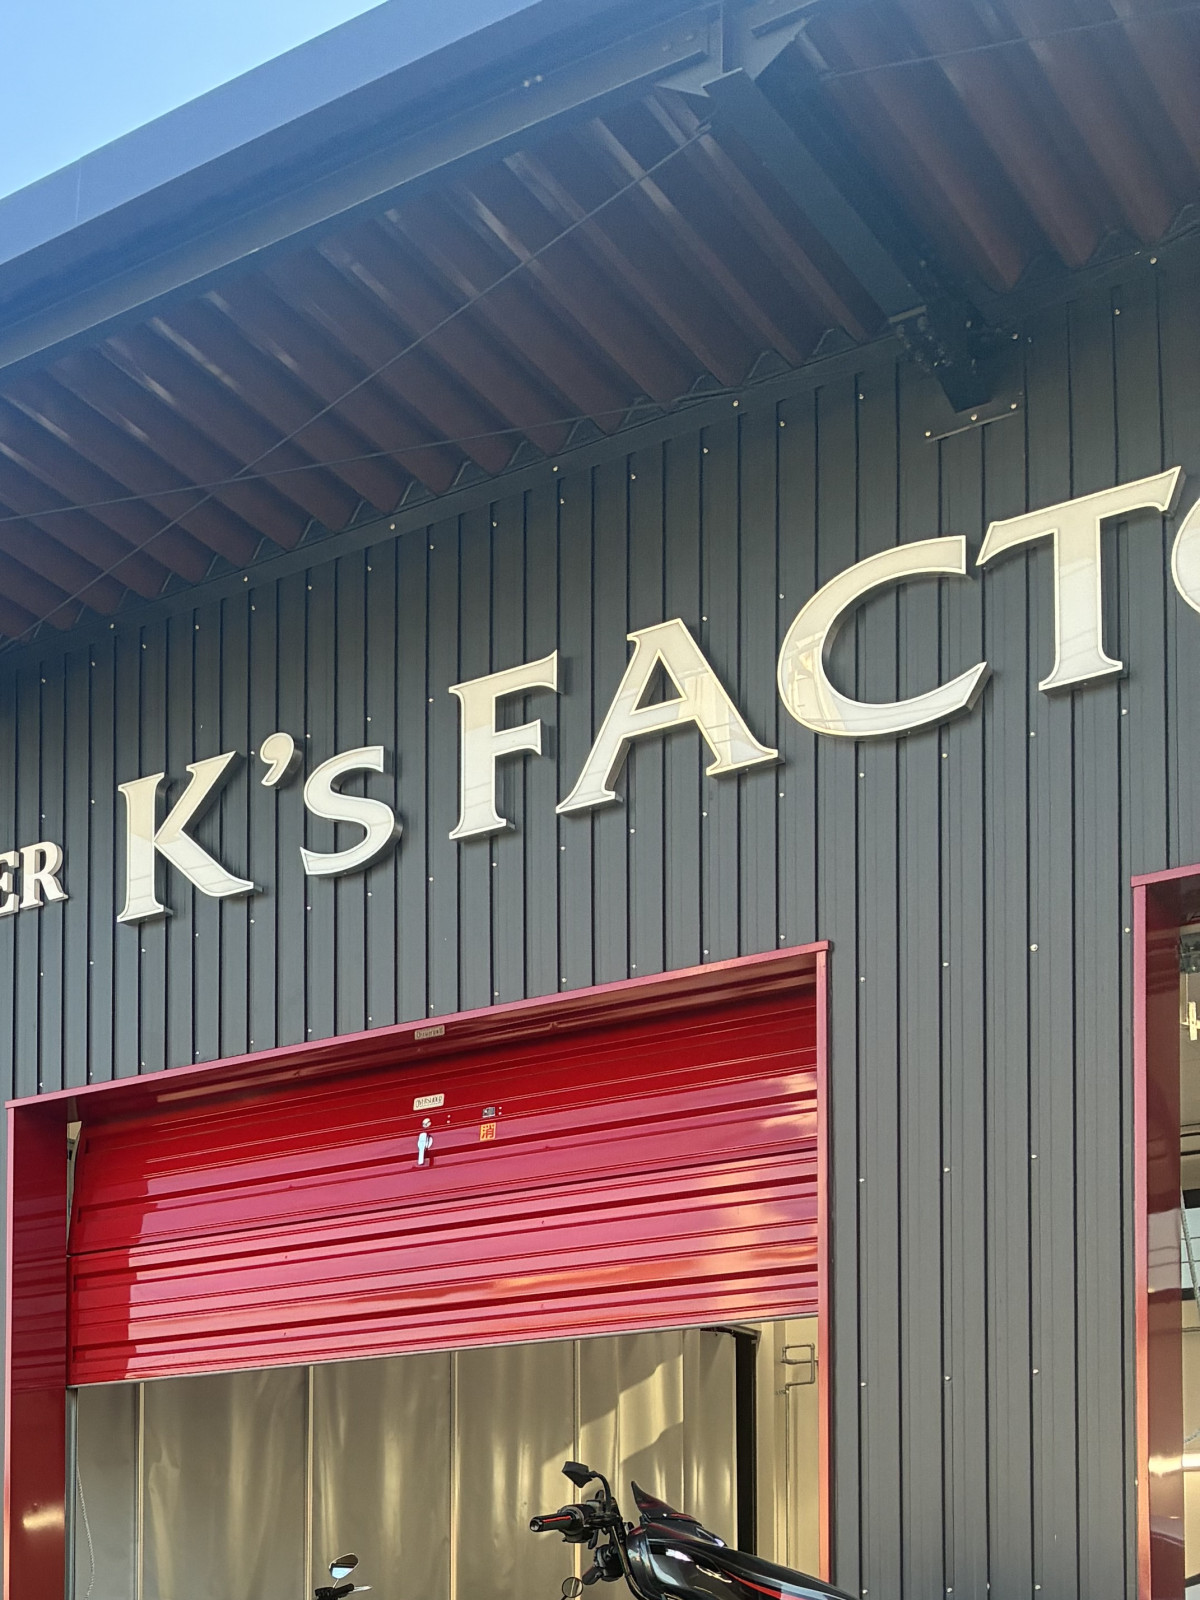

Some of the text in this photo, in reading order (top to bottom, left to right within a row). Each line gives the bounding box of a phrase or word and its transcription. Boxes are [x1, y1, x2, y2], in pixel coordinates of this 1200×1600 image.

[117, 465, 1200, 923] K's FACT
[481, 1124, 495, 1140] 消
